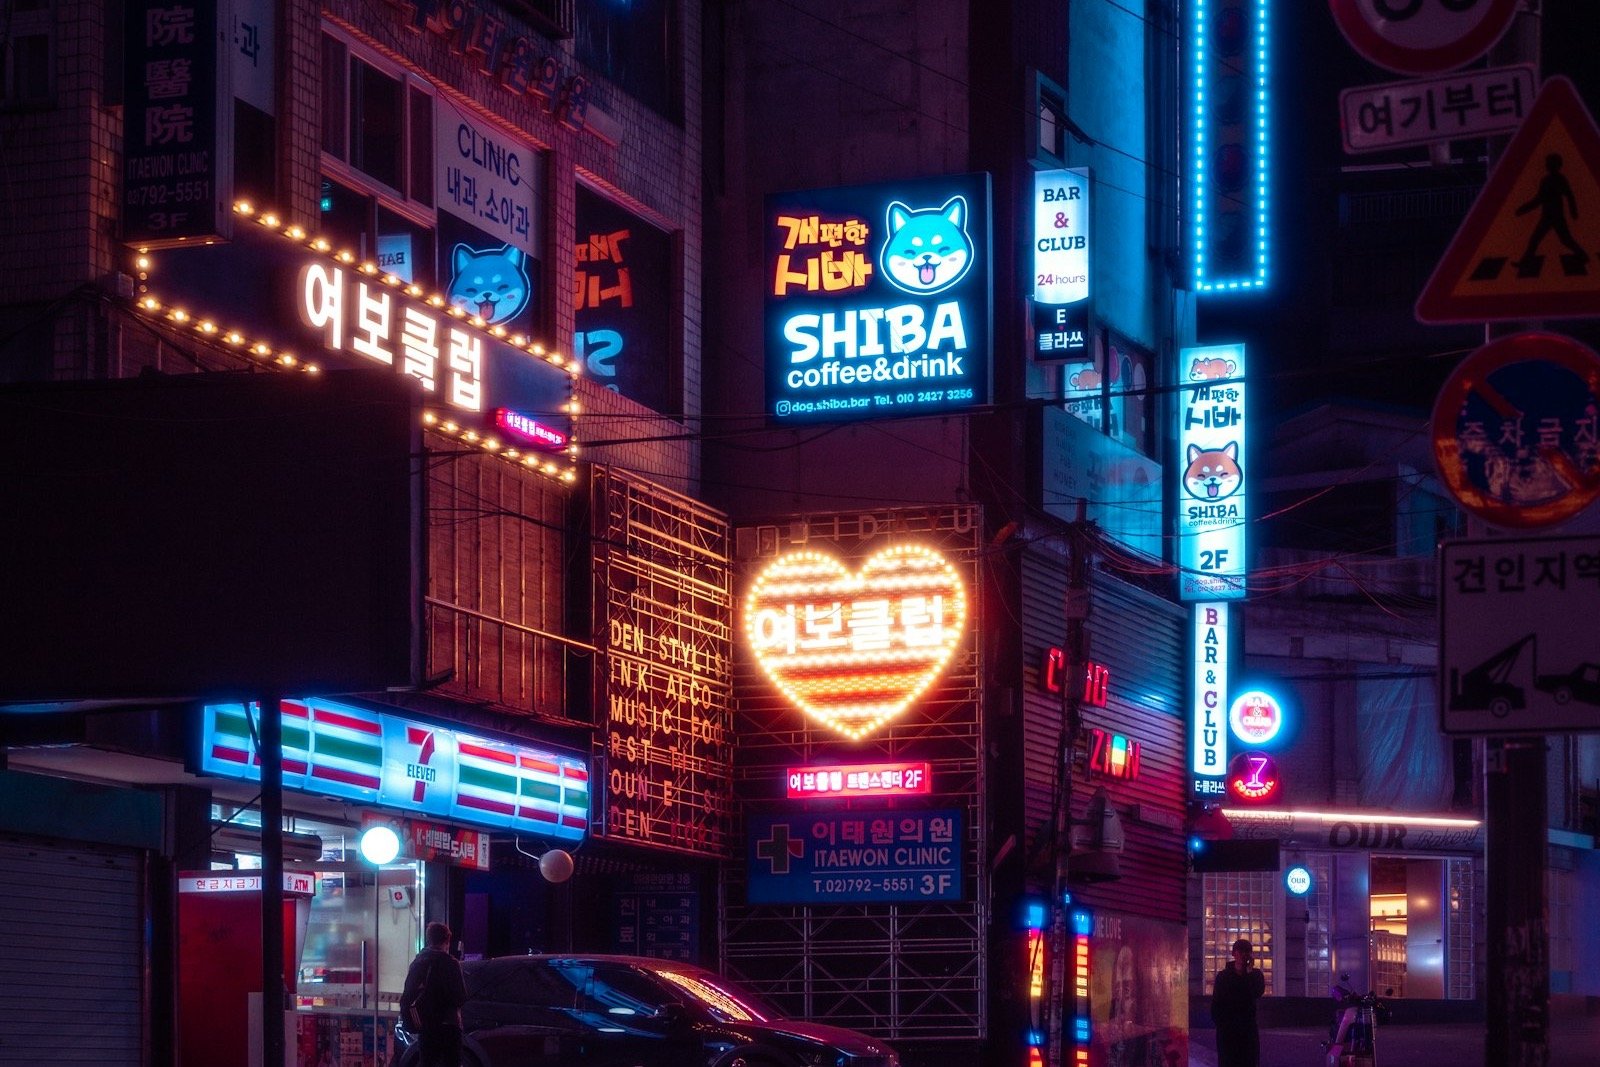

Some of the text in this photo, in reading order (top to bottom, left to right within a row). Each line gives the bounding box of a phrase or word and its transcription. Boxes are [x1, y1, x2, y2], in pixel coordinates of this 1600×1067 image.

[1358, 78, 1522, 136] 여기부터
[128, 149, 208, 181] ITAEWON CLINIC
[457, 123, 519, 186] CLINIC
[1043, 186, 1080, 202] BAR
[148, 211, 189, 230] 3F
[1053, 211, 1069, 228] &
[777, 216, 869, 250] 개편한
[1037, 235, 1086, 252] CLUB
[774, 250, 872, 296] 시바
[1037, 273, 1086, 286] 24 hours
[1056, 308, 1067, 324] E
[304, 264, 482, 412] 여보클럽
[783, 301, 967, 364] SHIBA
[1039, 331, 1084, 351] 클라쓰
[787, 351, 965, 388] coffee&drink
[874, 394, 894, 406] Tel.
[896, 393, 915, 404] 010
[917, 391, 944, 402] 2427
[946, 388, 974, 400] 3256
[1185, 406, 1241, 430] 시바
[1187, 504, 1238, 519] SHIBA
[1199, 549, 1229, 570] 2F
[1454, 551, 1600, 593] 견인지역
[611, 693, 672, 734] MUSIC
[407, 763, 436, 783] ELEVEN
[905, 769, 922, 788] 2F
[811, 818, 953, 845] 이태원의원
[1328, 821, 1407, 848] OUR
[814, 847, 951, 867] ITAEWON CLINIC
[196, 878, 259, 890] 현금지급기
[294, 879, 308, 892] ATM
[919, 874, 951, 895] 3F
